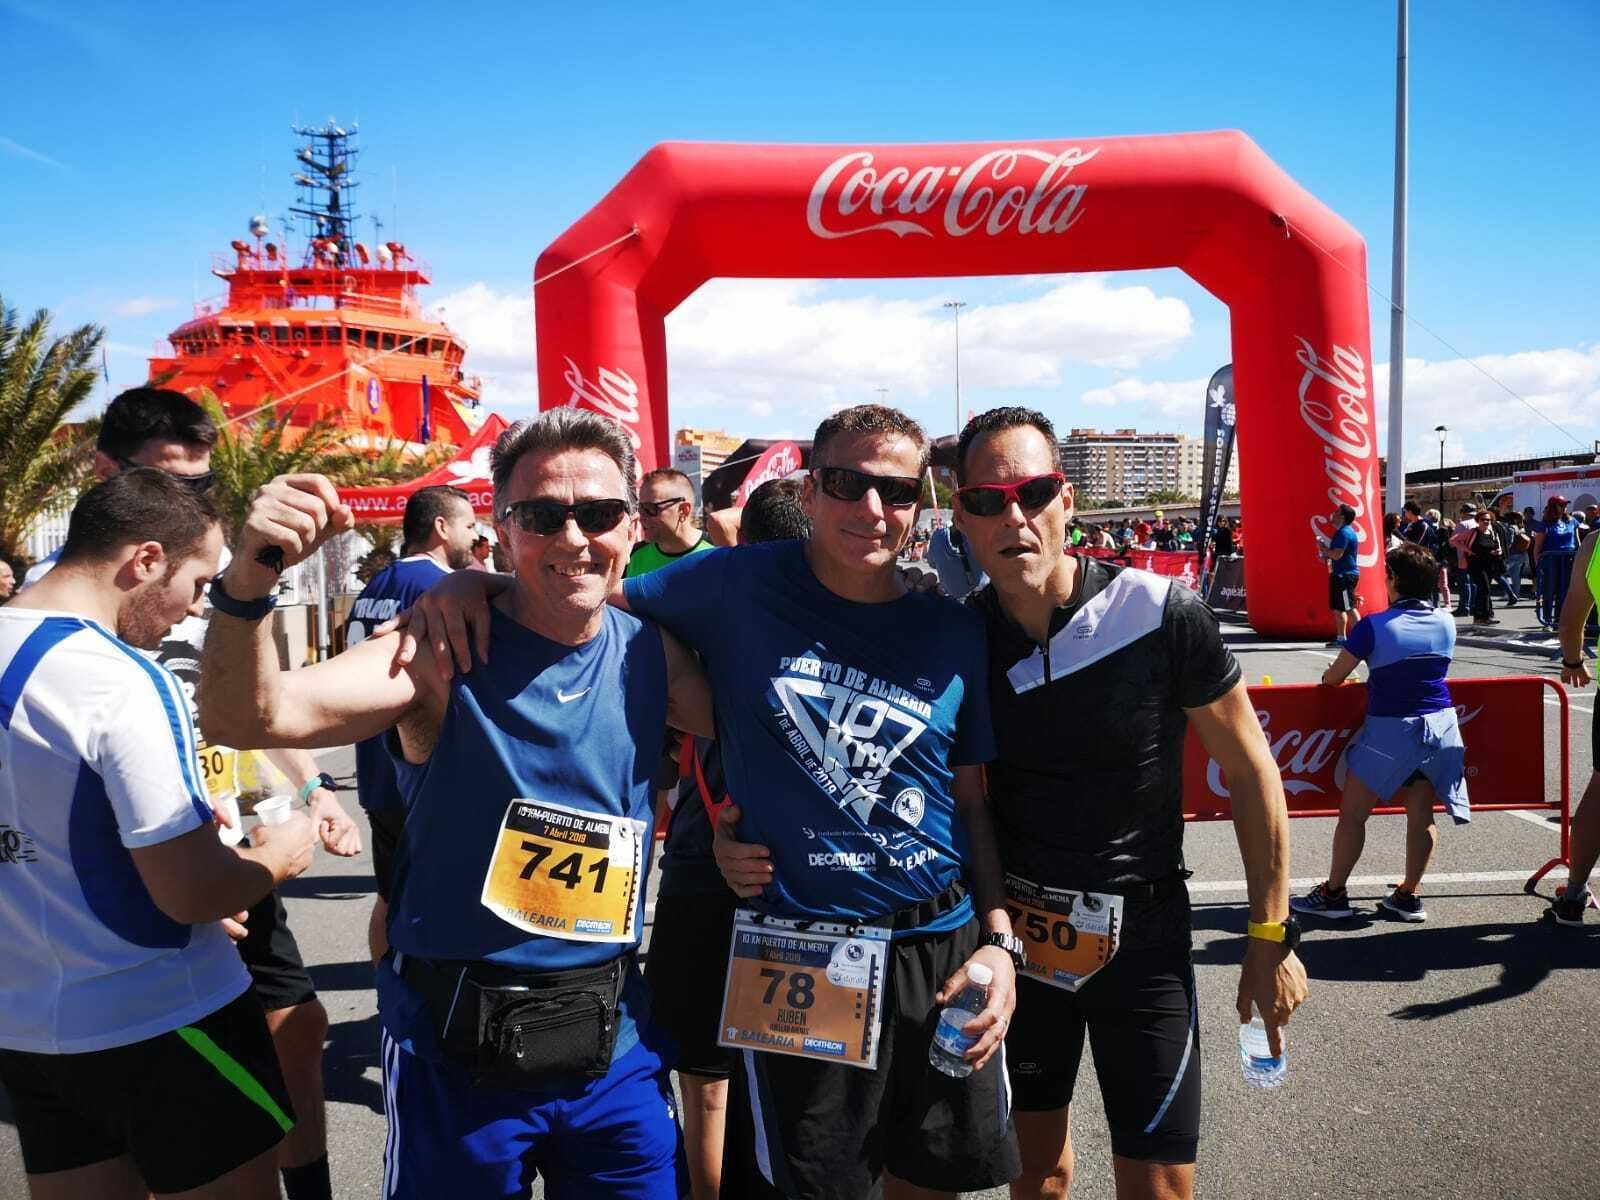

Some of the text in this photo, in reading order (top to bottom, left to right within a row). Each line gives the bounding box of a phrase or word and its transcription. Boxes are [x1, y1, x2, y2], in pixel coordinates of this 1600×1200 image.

[806, 147, 1101, 239] Coca-Cola
[779, 656, 932, 719] PUERTO DE ALMERIA
[774, 708, 838, 794] 7 DE ABRIL DE 2019
[540, 811, 573, 828] PUERTO
[572, 819, 585, 831] DE
[549, 827, 568, 840] Abril
[568, 831, 587, 843] 2019
[520, 840, 609, 893] 741
[808, 852, 877, 867] DECATHLON
[788, 938, 798, 950] DE
[798, 940, 829, 953] ALMERIA
[759, 967, 815, 1010] 78
[776, 1008, 807, 1026] RUBEN
